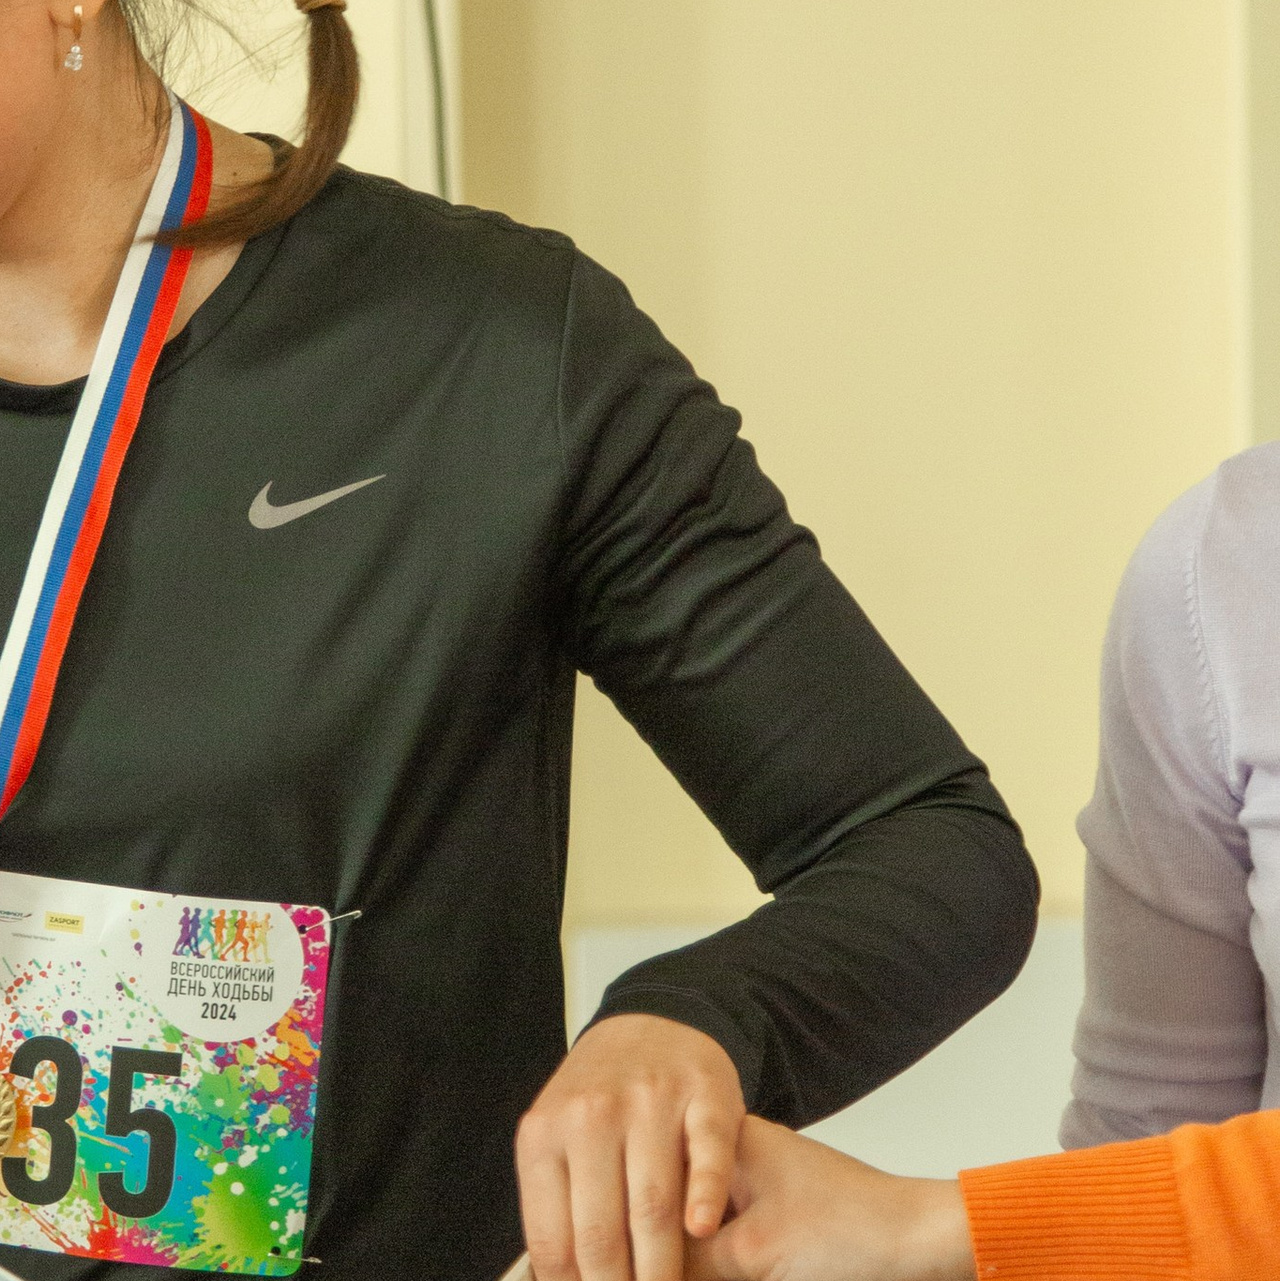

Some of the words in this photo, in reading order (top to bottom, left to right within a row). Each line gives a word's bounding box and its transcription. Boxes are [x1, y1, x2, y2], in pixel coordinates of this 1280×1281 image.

[49, 916, 80, 926] ZASPORT
[170, 961, 275, 983] ВСЕРОССИЙСКИЙ
[167, 978, 207, 997] ДЕНЬ
[212, 982, 273, 1002] ХОДЬБЫ
[201, 1002, 237, 1021] 2024
